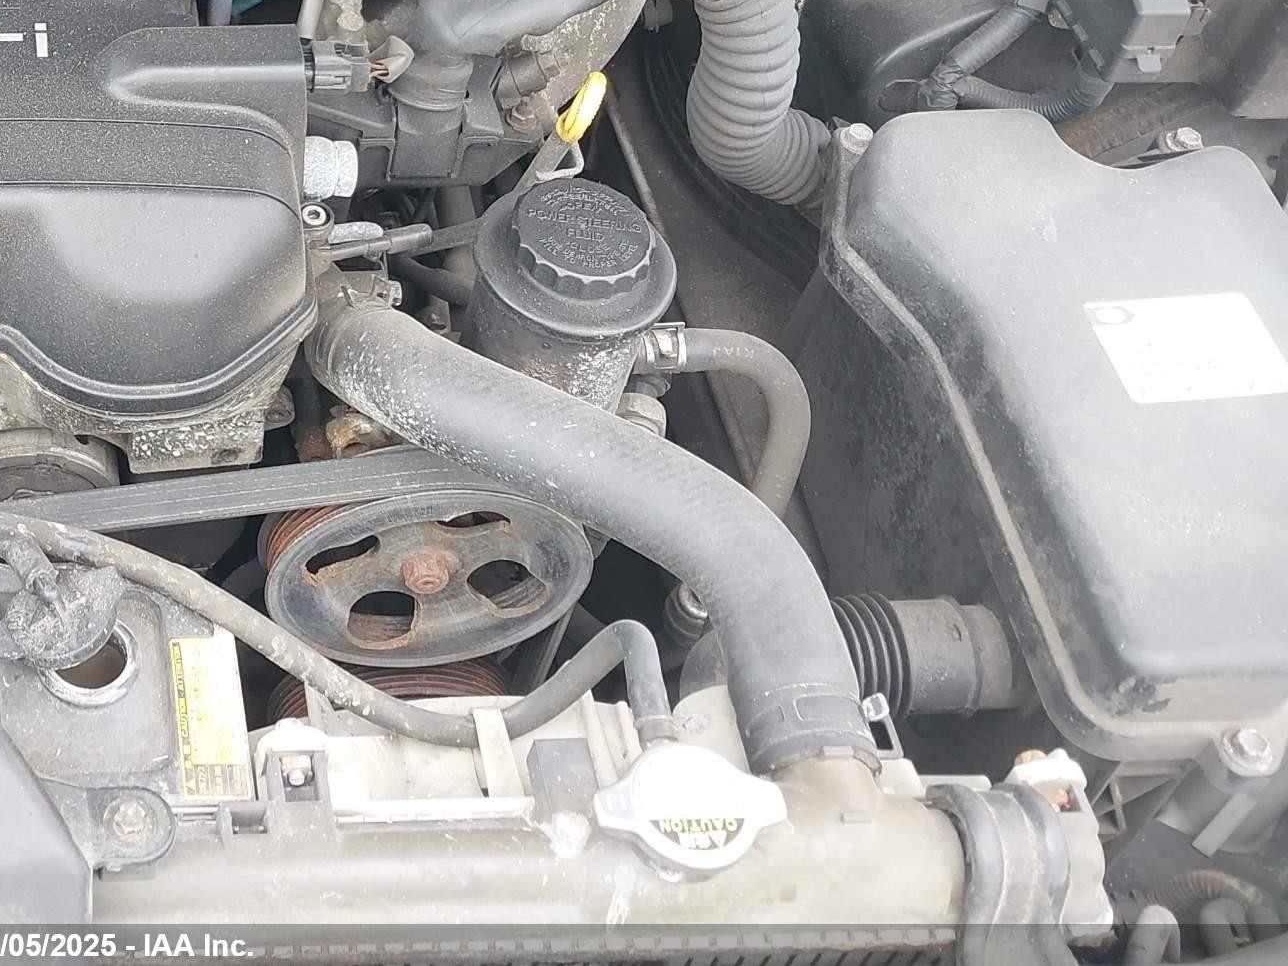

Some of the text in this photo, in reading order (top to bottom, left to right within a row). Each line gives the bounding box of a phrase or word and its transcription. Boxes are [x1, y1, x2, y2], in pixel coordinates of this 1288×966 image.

[527, 209, 642, 233] POWER STEERING
[567, 228, 604, 241] FLUID
[658, 818, 738, 835] CAUTION
